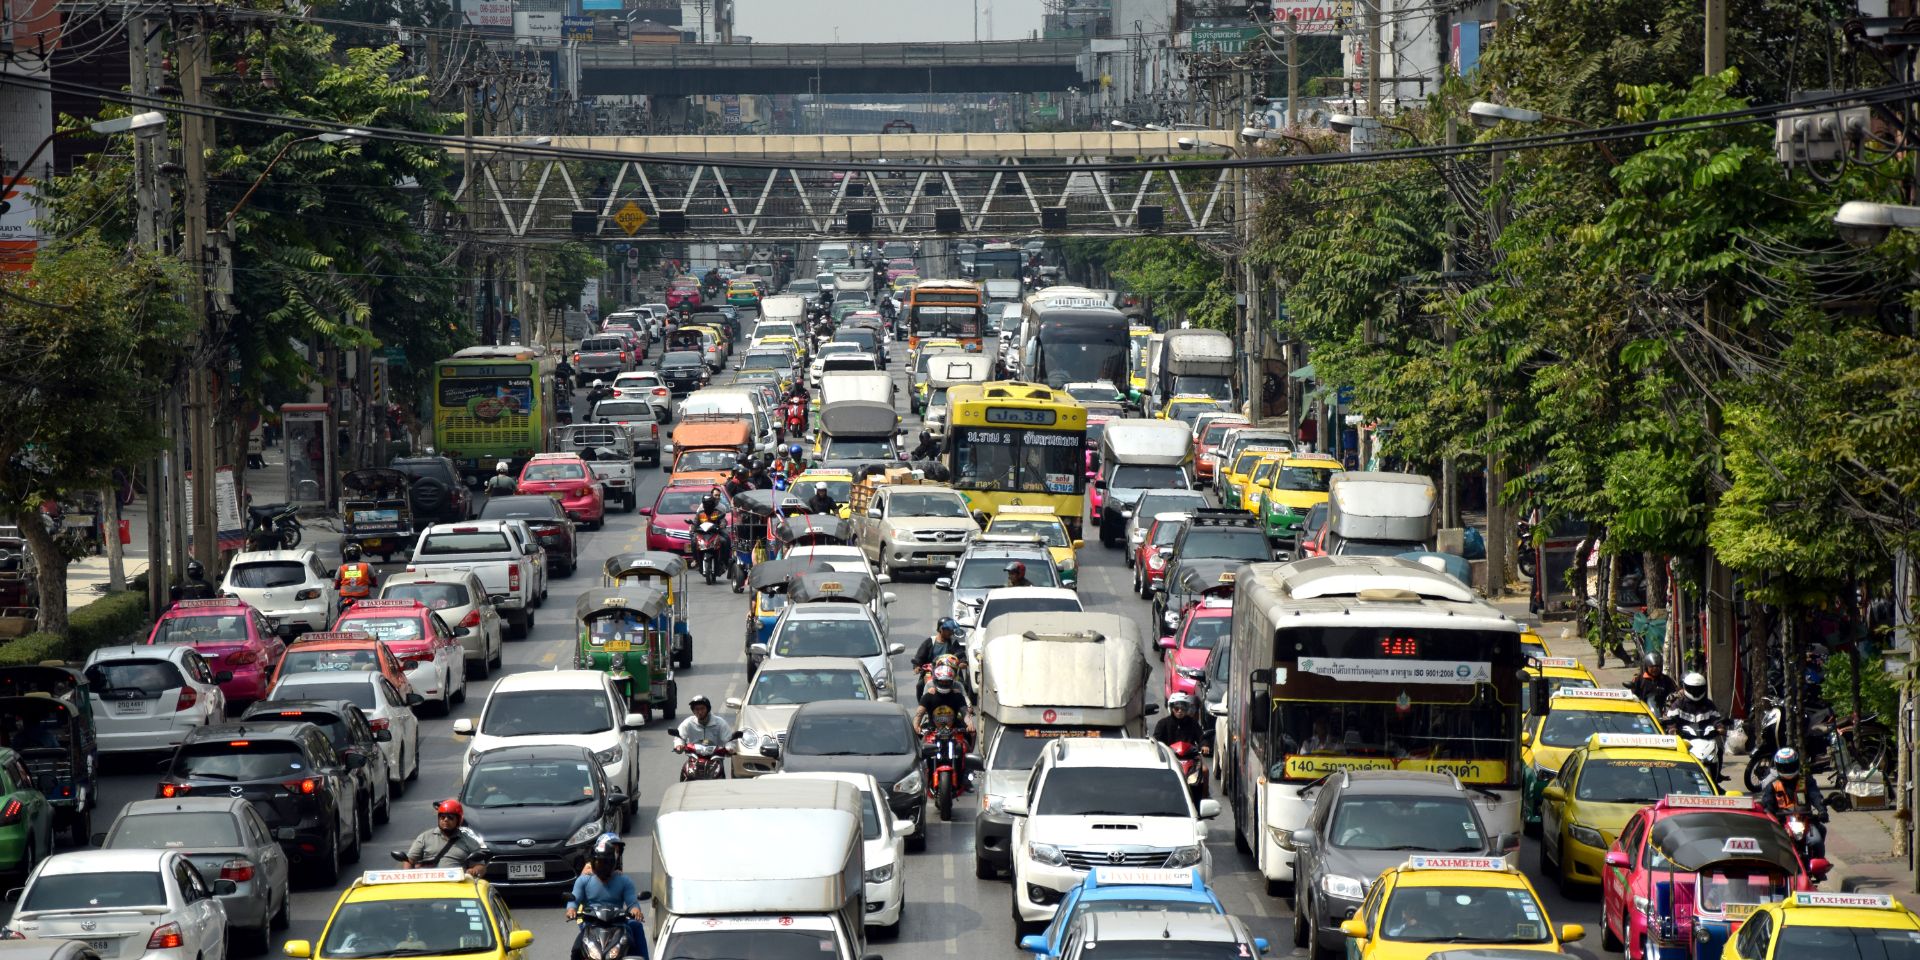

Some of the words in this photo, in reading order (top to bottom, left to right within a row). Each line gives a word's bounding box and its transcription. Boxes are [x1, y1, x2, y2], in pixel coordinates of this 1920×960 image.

[1381, 637, 1416, 655] 140
[1414, 669, 1424, 677] ISO
[1426, 669, 1455, 677] 9001:2008
[1575, 690, 1620, 698] TAXI-METER
[1610, 735, 1660, 745] TAXI-METER
[1290, 760, 1314, 772] 140
[1678, 796, 1736, 806] TAXI-METER
[1730, 840, 1755, 850] TAXI
[1426, 859, 1490, 867] TAXI-METER
[524, 864, 542, 873] 1102
[380, 872, 445, 881] TAXI-METER
[1811, 896, 1877, 906] TAXI-METER
